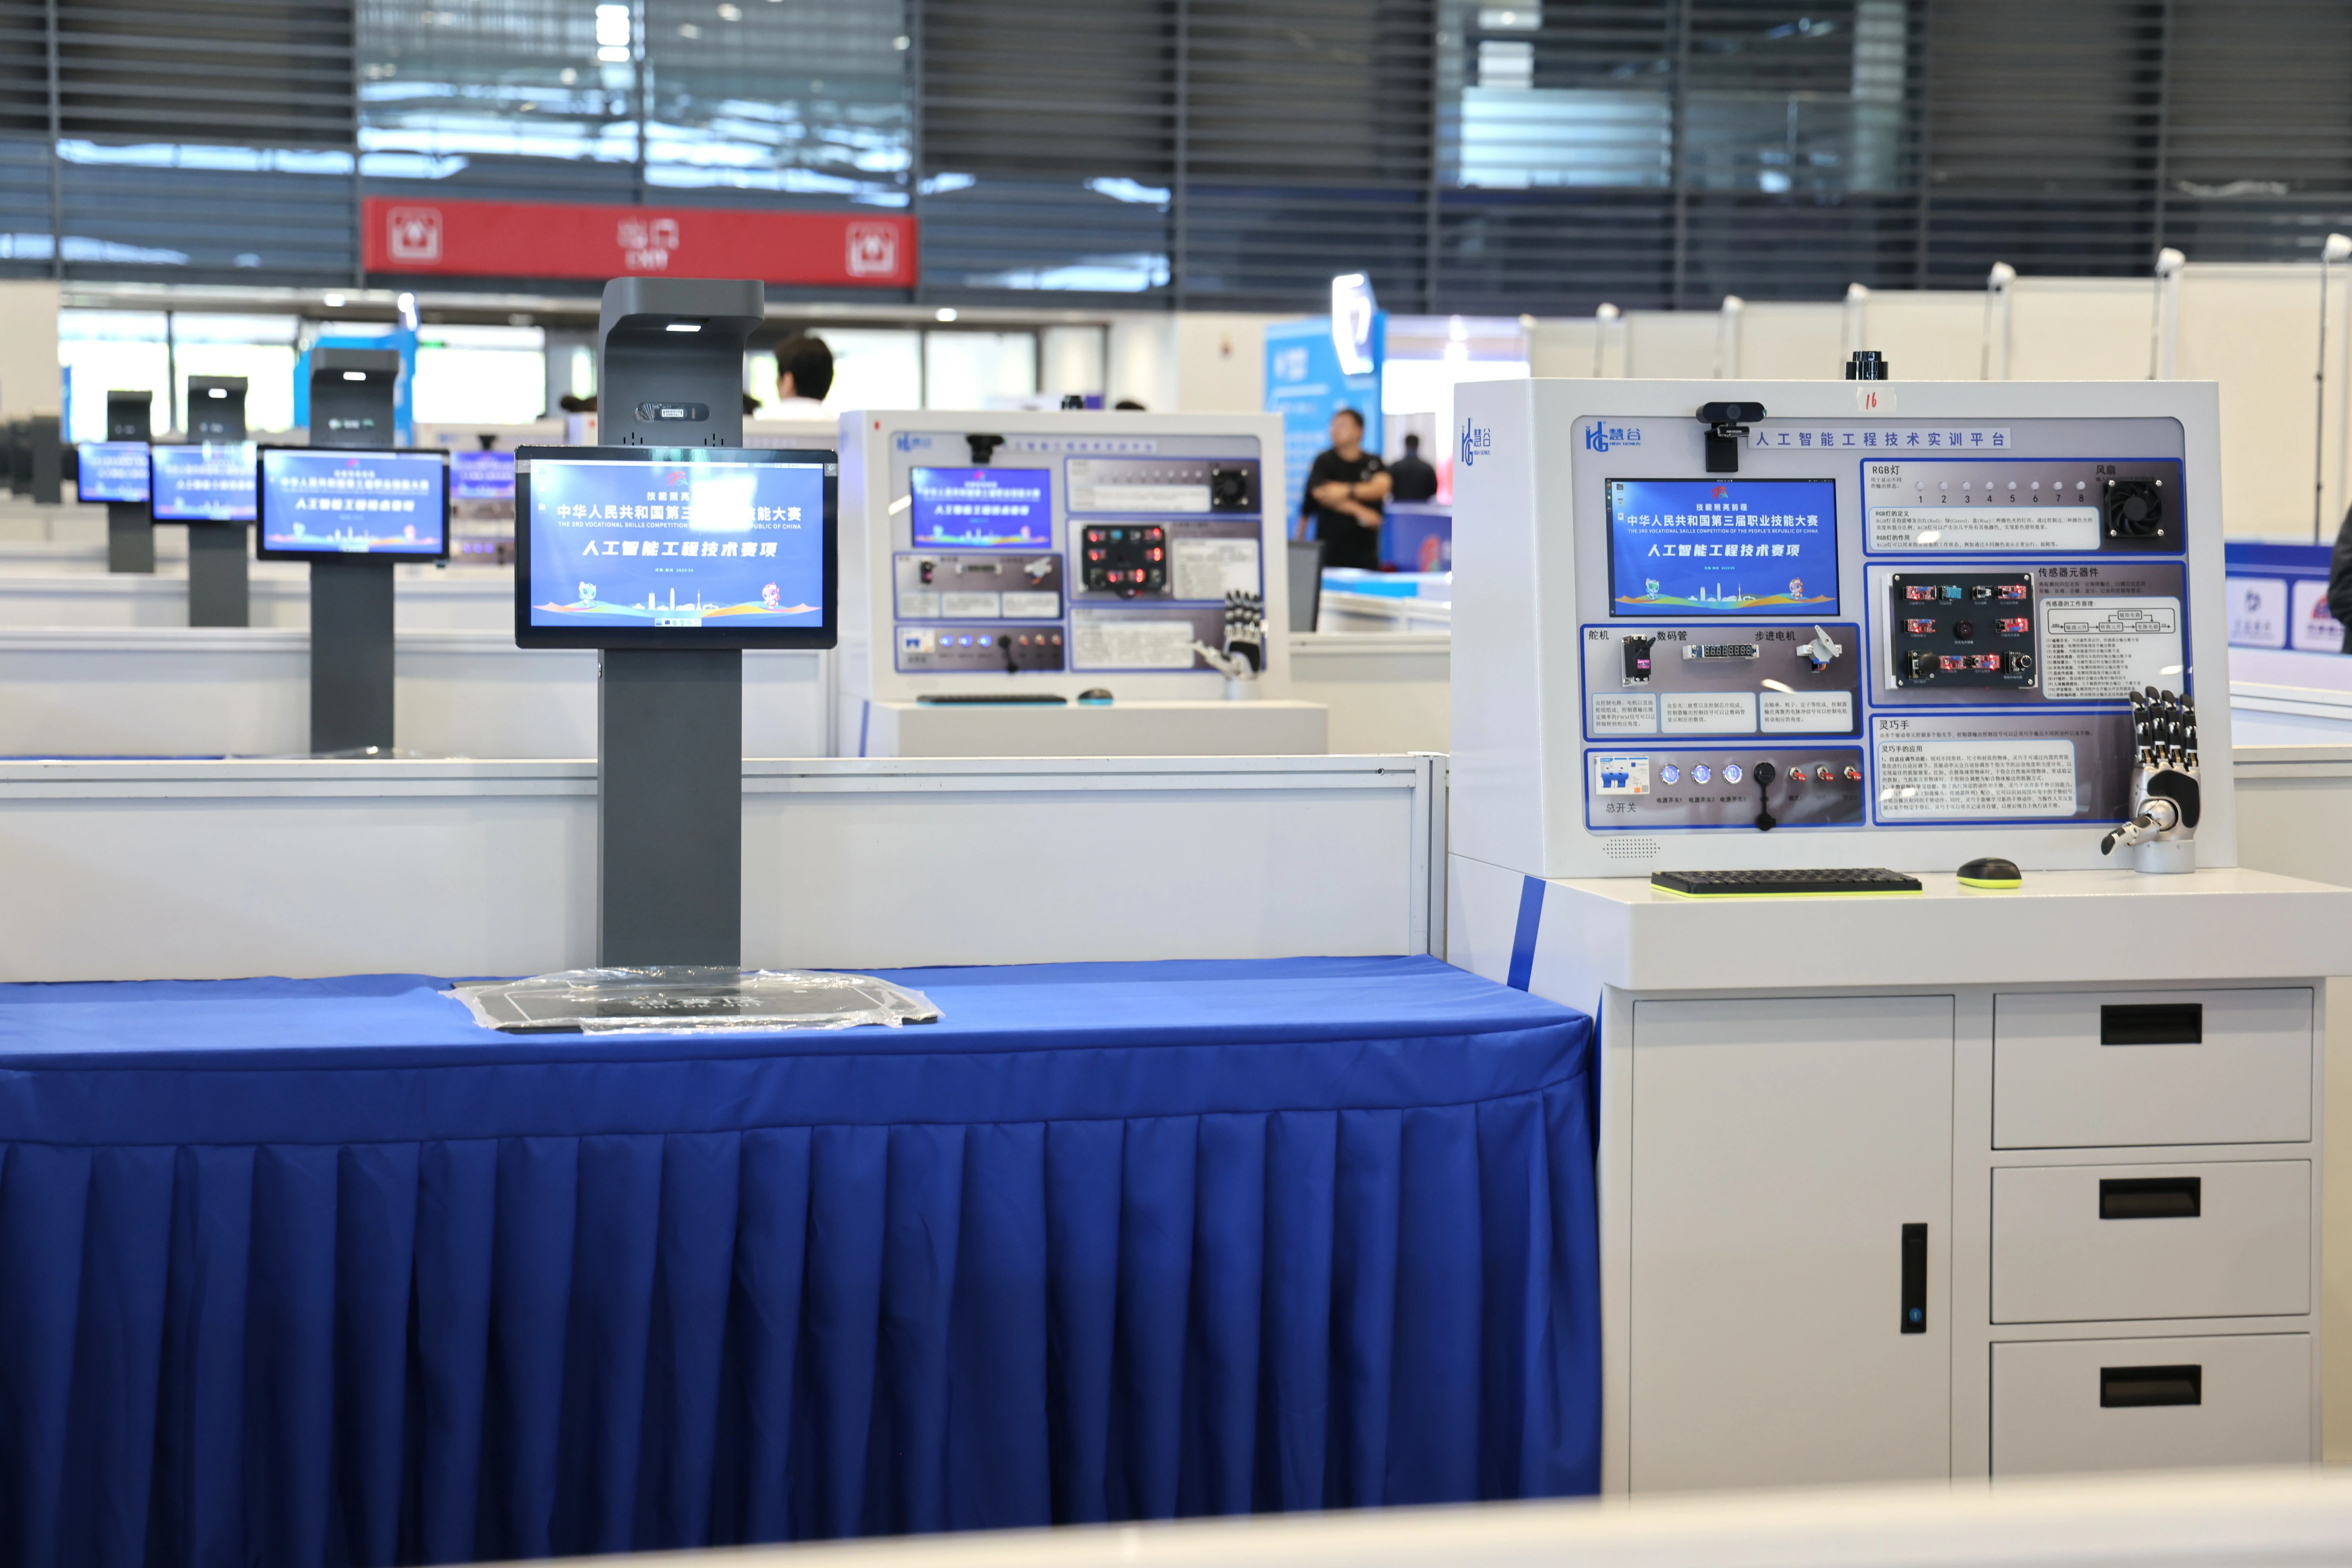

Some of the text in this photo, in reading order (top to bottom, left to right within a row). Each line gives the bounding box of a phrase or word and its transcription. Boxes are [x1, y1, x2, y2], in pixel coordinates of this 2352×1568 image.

[1866, 392, 1877, 410] 16
[1473, 428, 1490, 447] 慧谷
[1609, 428, 1641, 441] 慧谷
[1756, 432, 2005, 447] 人工智能工程技术实训平台
[1872, 465, 1900, 475] RGB灯
[2096, 465, 2116, 475] 风扇
[1941, 495, 1947, 503] 2
[1696, 503, 1748, 512] 技能照亮前程
[1627, 514, 1818, 527] 中华人民共和国第三届职业技能大赛
[583, 540, 778, 557] 人工智能工程技术赛项
[1647, 544, 1800, 557] 人工智能工程技术赛项
[2038, 567, 2099, 578] 传感器元器件
[1589, 630, 1609, 640] 舵机
[1657, 630, 1687, 641] 数码管
[1755, 631, 1795, 641] 步进电机
[1879, 720, 1909, 730] 灵巧手
[1606, 803, 1636, 813] 总开关
